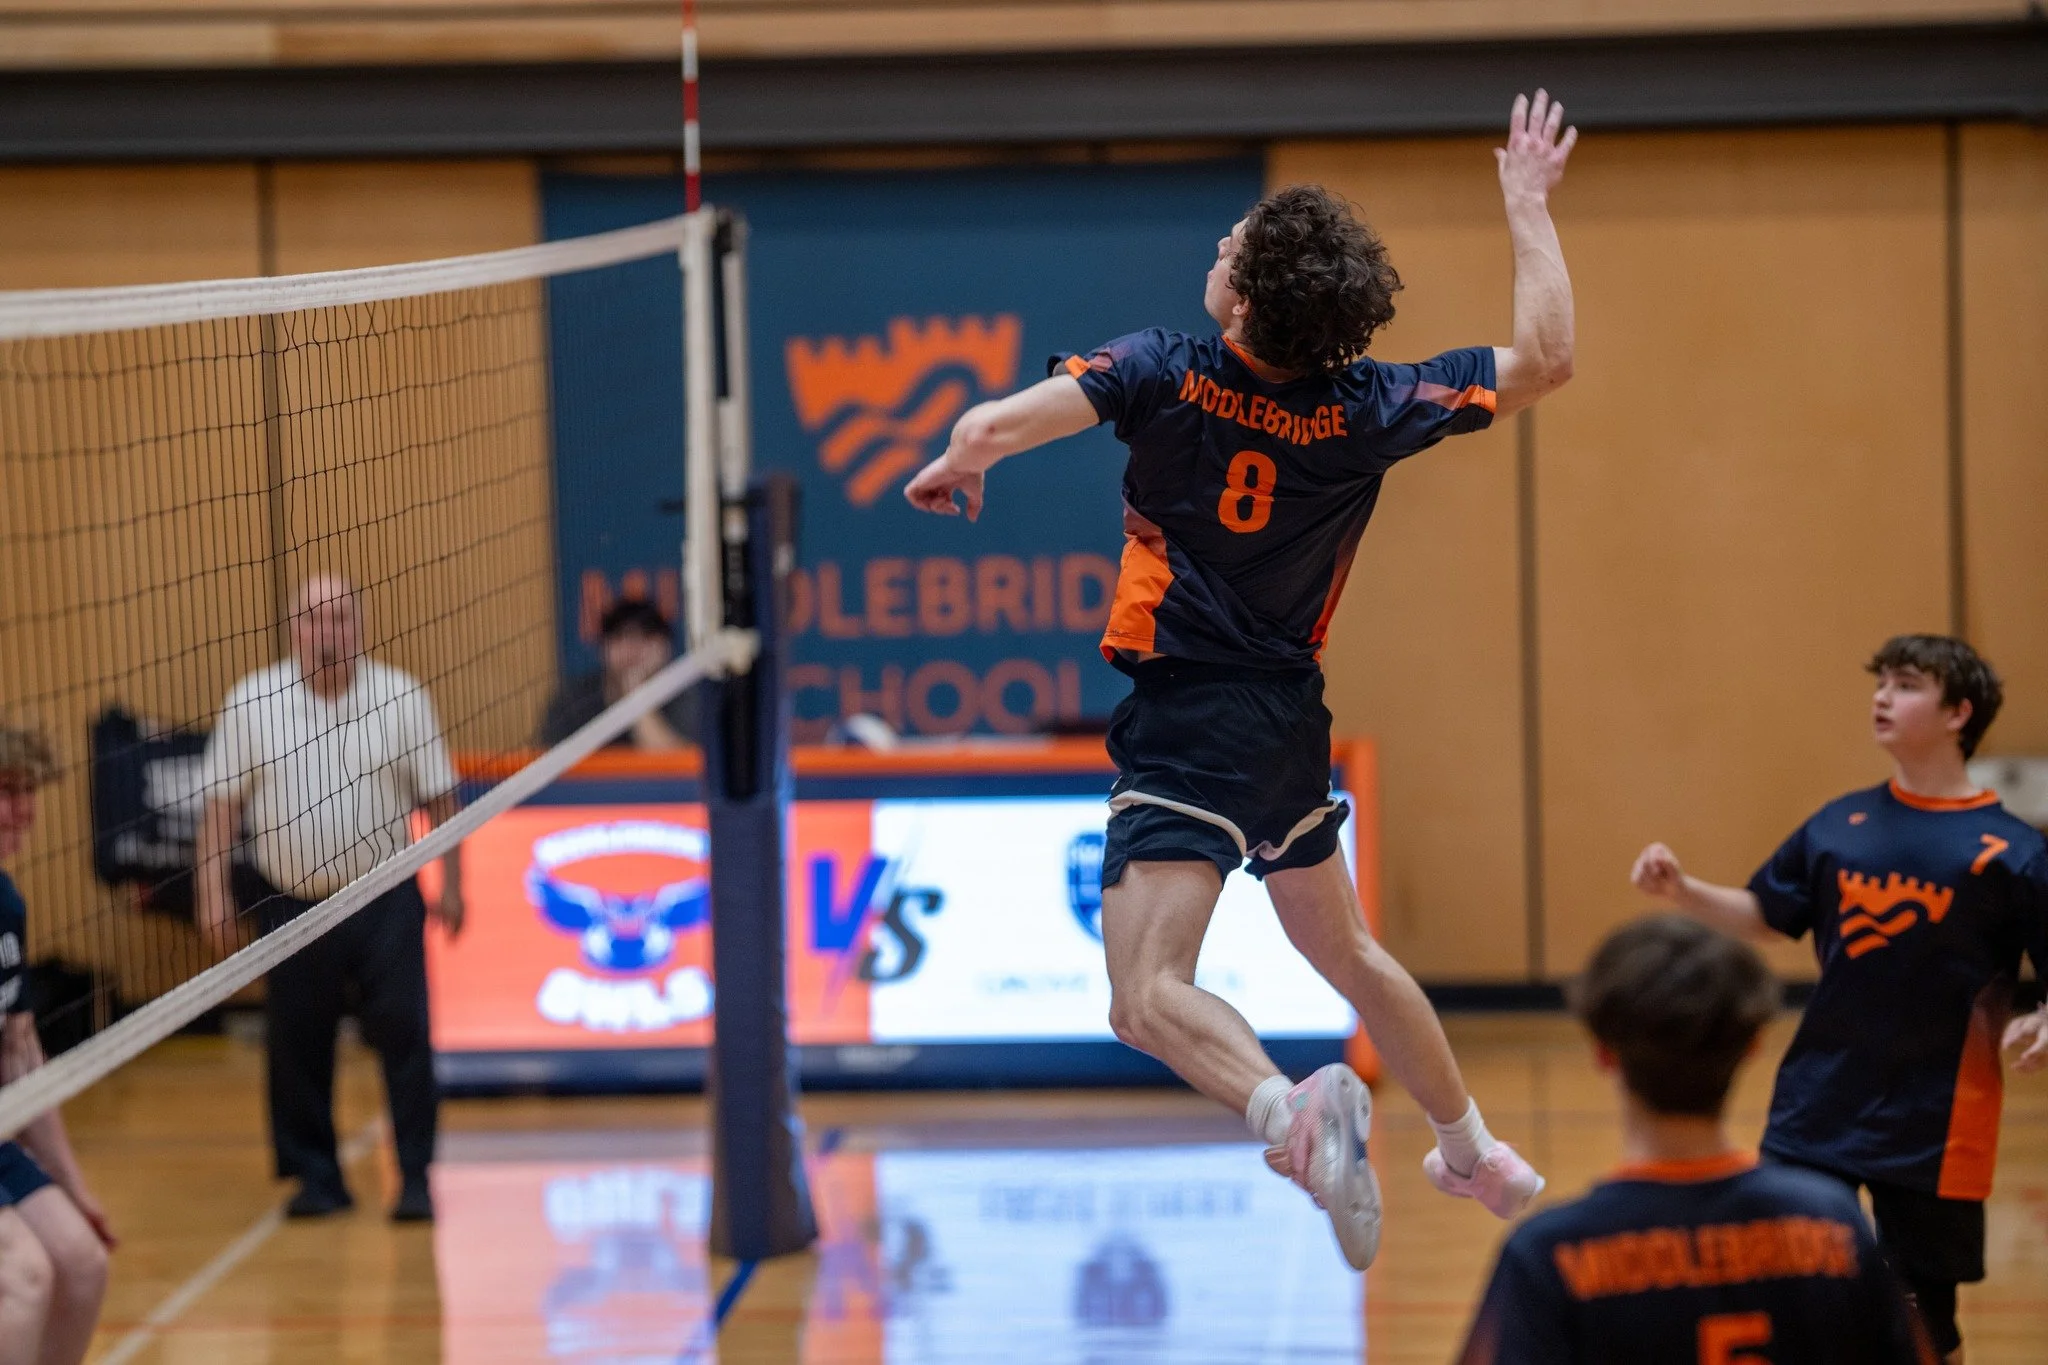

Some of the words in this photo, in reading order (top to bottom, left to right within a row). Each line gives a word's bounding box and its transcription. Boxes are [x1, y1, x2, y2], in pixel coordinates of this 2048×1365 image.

[1178, 368, 1348, 446] MDDLEBRIDGE
[1217, 450, 1277, 533] 8
[1970, 834, 2009, 875] 7
[809, 855, 943, 984] VS
